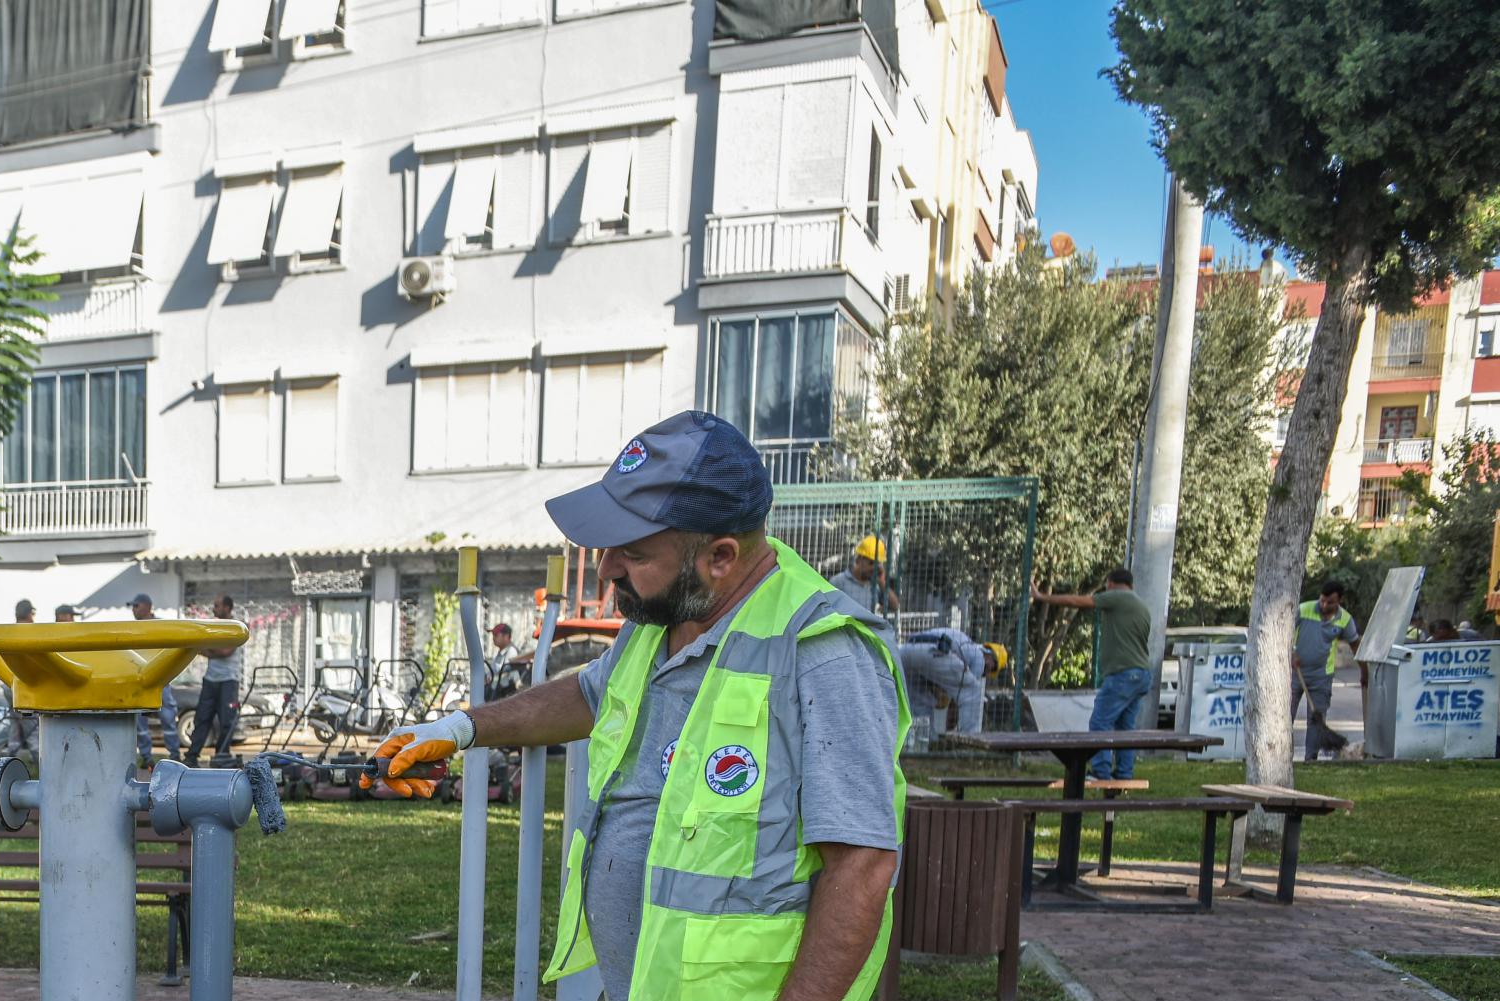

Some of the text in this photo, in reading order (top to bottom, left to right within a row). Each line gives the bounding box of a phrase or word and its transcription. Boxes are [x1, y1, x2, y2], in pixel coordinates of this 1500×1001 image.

[1422, 648, 1492, 666] MOLOZ
[1414, 689, 1485, 711] ATEŞ
[712, 747, 756, 769] KEPEZ
